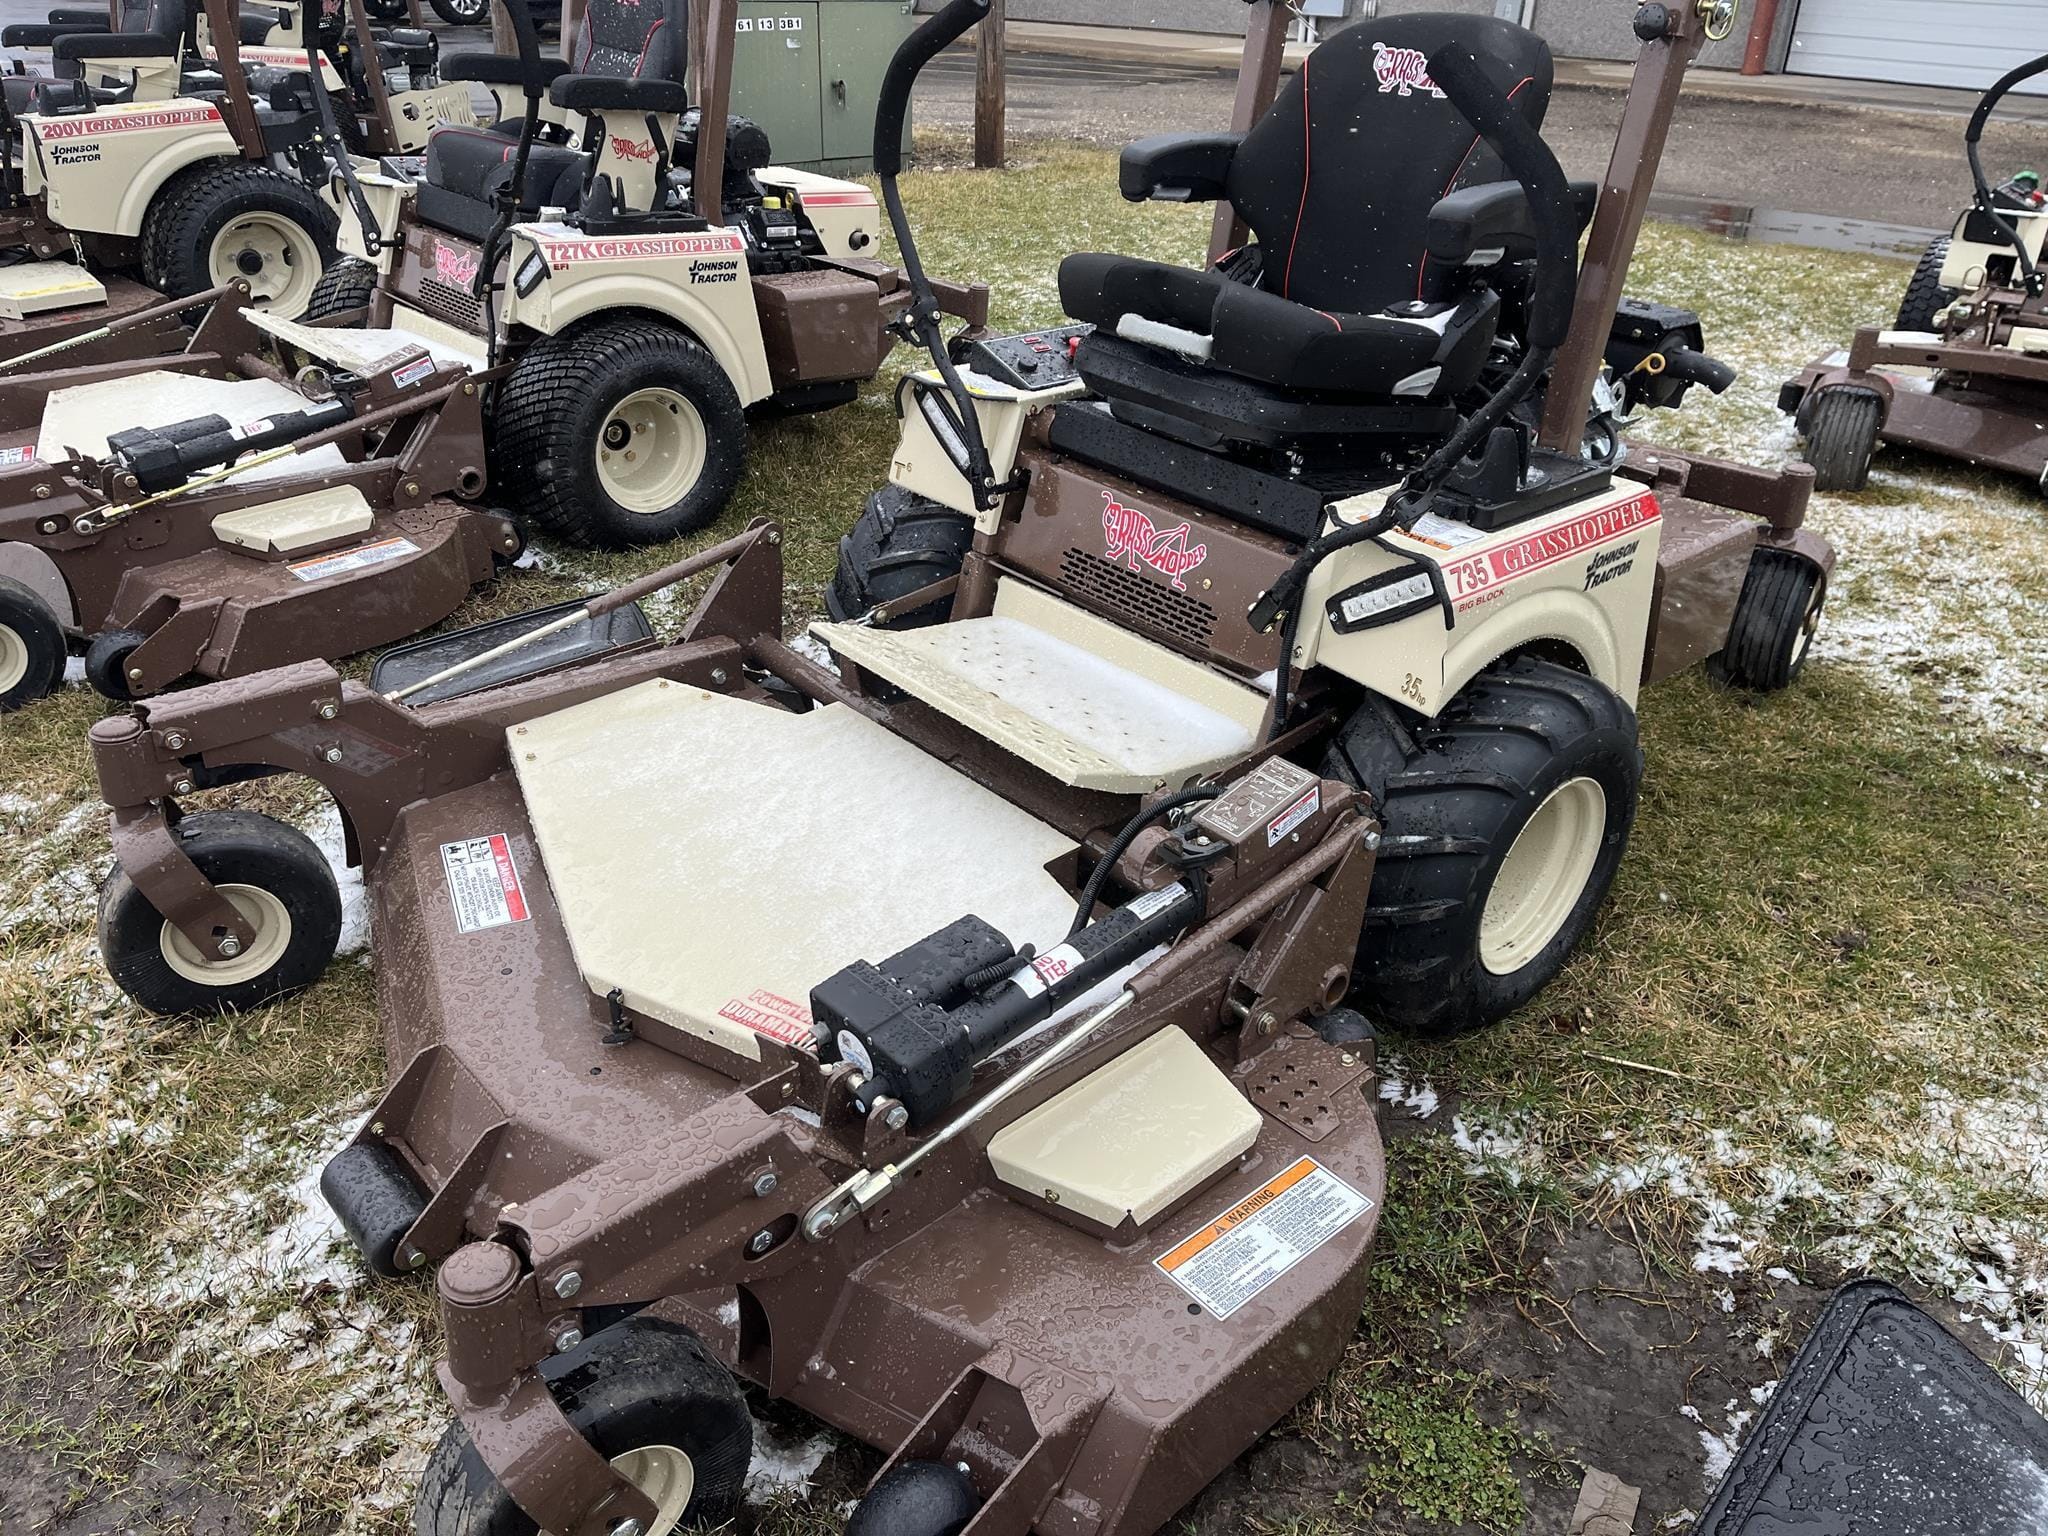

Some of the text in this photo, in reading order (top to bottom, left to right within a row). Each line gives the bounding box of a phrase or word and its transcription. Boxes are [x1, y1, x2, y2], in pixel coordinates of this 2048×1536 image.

[738, 18, 800, 30] 61 13 3B1
[42, 110, 210, 139] 200V GRASSHOPPER
[50, 143, 100, 156] JOHNSON
[53, 154, 102, 165] TRACTOR
[545, 237, 733, 261] 727K GRASSHOPPER
[553, 263, 570, 271] EFI
[688, 259, 738, 272] JOHNSON
[690, 272, 737, 284] TRACTOR
[1449, 500, 1644, 594] 735 GRASSHOPPER
[1586, 540, 1640, 573] JOHNSON
[1583, 560, 1634, 592] TRACTOR
[1459, 588, 1506, 613] BIG BLOCK
[498, 861, 516, 892] DANGER
[721, 999, 801, 1041] DURAMAX
[1225, 1188, 1275, 1225] WARNING
